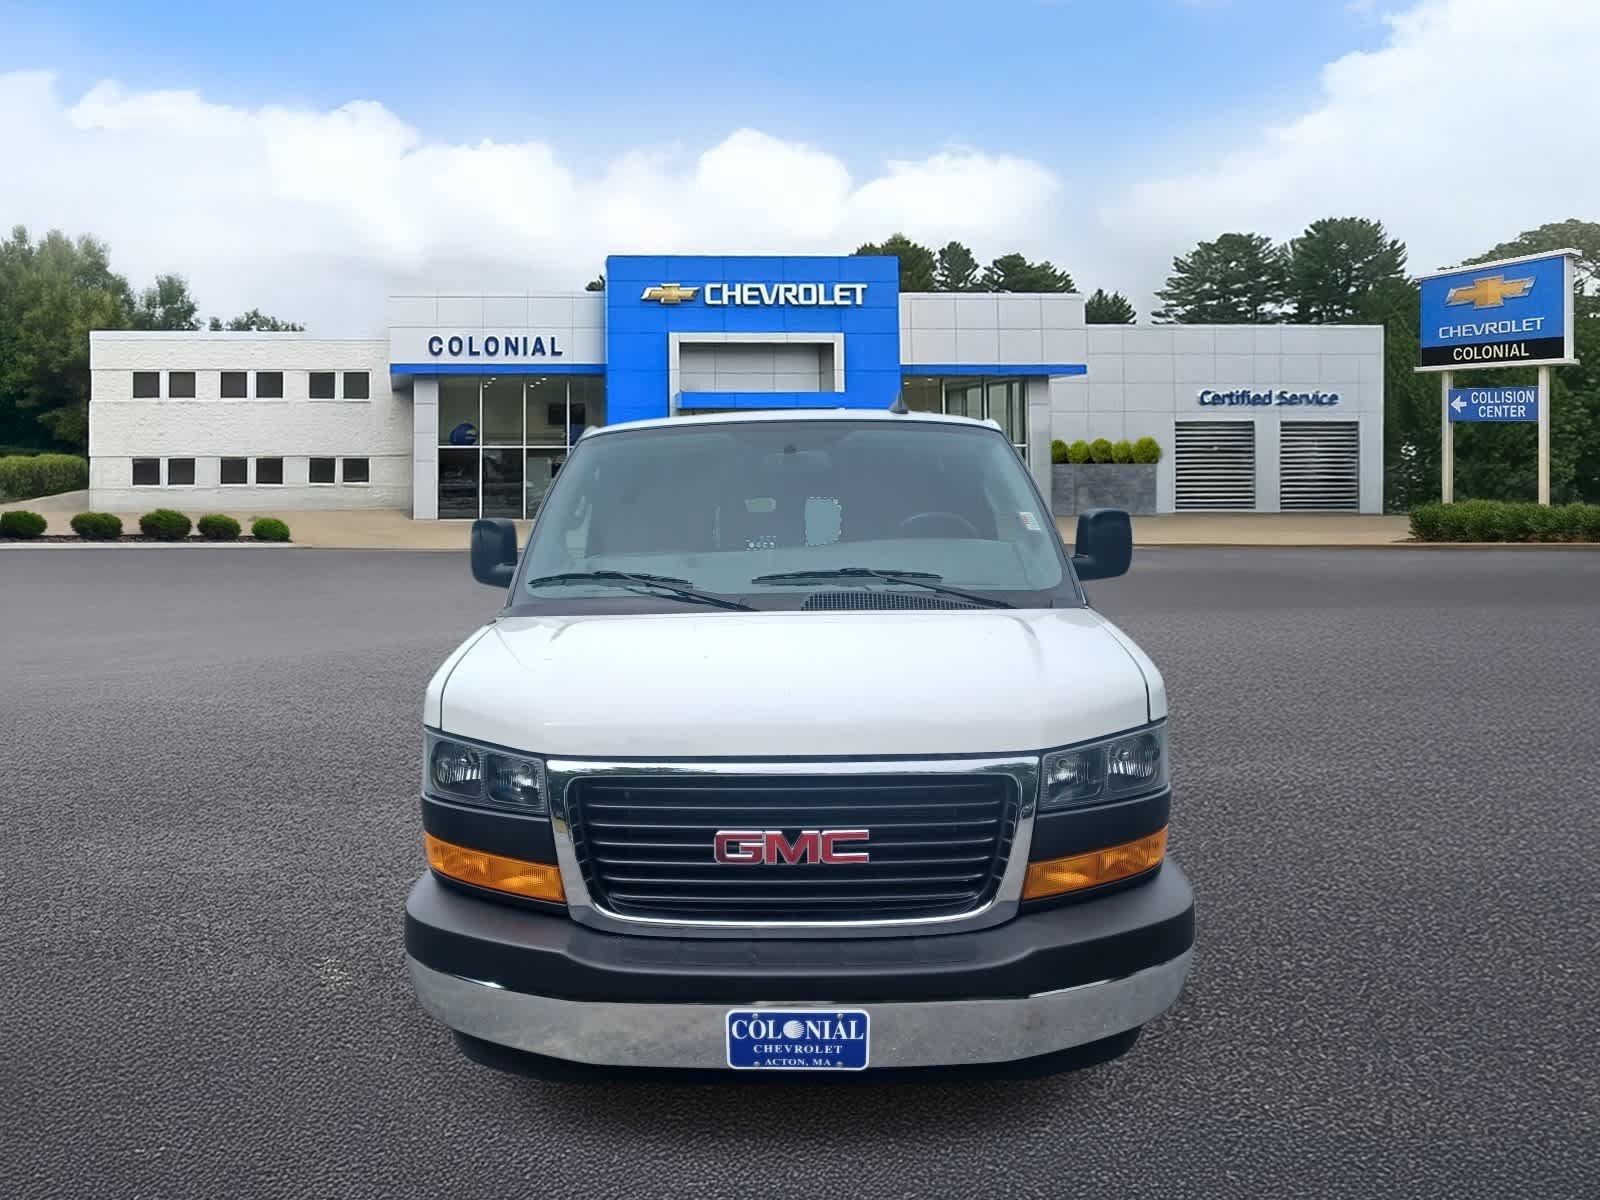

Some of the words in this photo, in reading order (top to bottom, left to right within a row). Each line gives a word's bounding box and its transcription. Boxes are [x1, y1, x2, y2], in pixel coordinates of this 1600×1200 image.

[704, 283, 868, 306] CHEVROLET
[1438, 316, 1545, 339] CHEVROLET
[428, 335, 564, 357] COLONIAL
[1452, 342, 1530, 361] COLONIAL
[1198, 389, 1273, 406] Certified
[1276, 390, 1339, 406] Service
[1471, 390, 1535, 404] COLLISION
[1478, 405, 1526, 418] CENTER
[714, 829, 869, 864] GMC
[752, 1044, 843, 1054] CHEVROLET
[764, 1058, 809, 1067] ACTON,
[812, 1058, 831, 1066] MA
